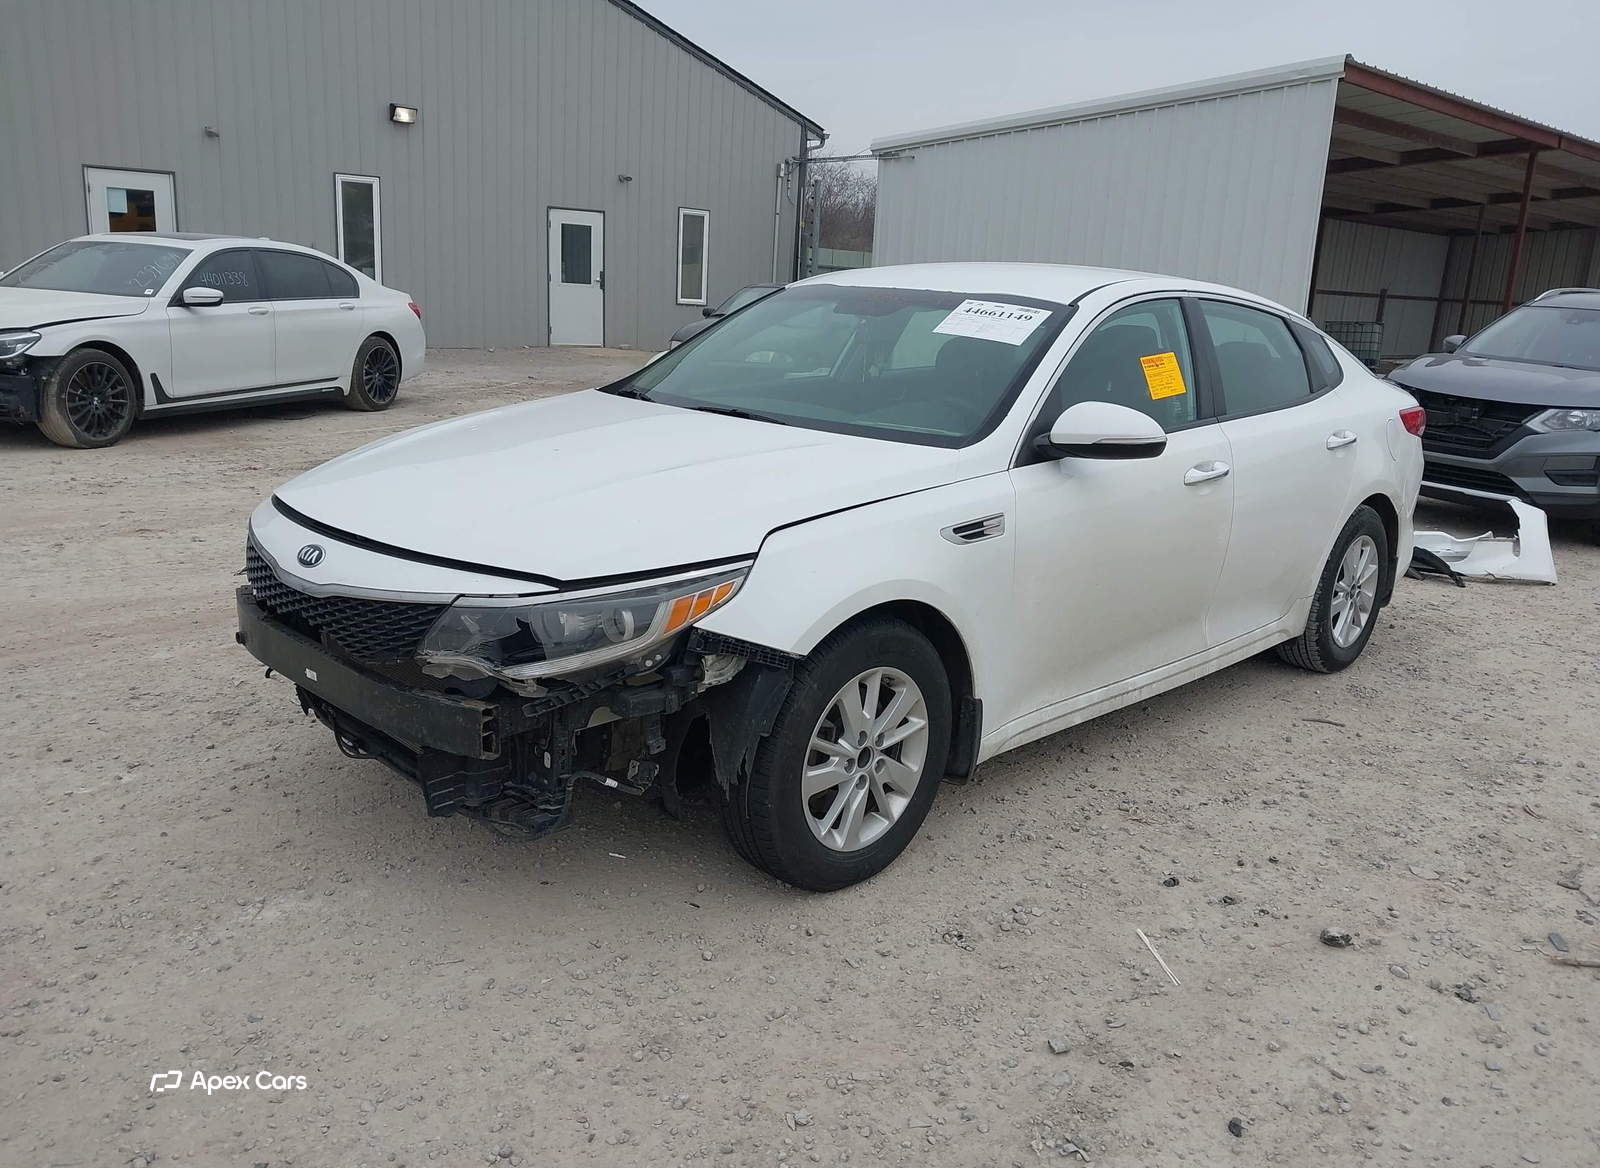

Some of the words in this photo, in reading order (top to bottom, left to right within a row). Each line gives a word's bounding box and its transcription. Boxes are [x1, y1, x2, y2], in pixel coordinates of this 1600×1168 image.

[200, 271, 249, 287] 44011338
[963, 307, 1033, 321] 44661149
[298, 546, 320, 564] KIA
